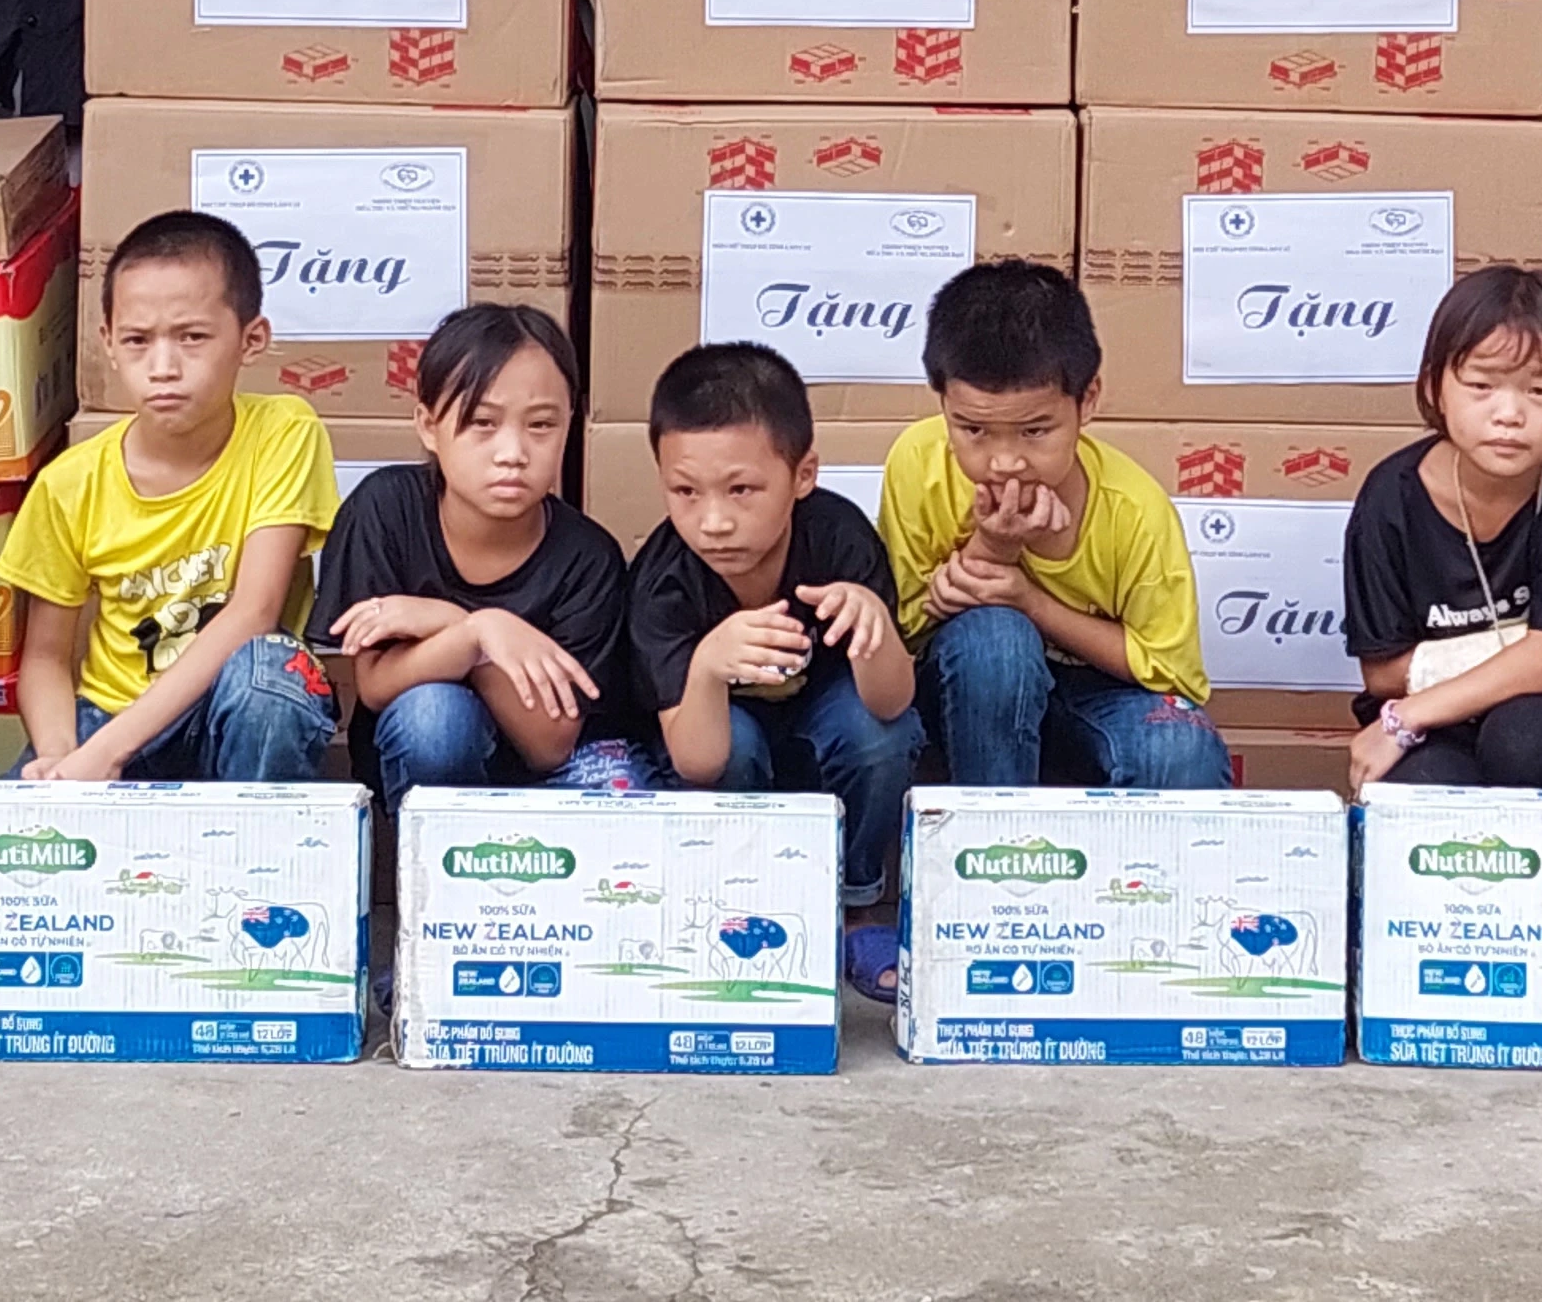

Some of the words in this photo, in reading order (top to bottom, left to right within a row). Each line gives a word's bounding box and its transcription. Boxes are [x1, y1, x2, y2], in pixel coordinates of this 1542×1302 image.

[254, 240, 410, 295] Tặng
[757, 282, 917, 339] Tặng
[1237, 284, 1398, 339] Tặng
[120, 543, 231, 600] MICKEY
[1215, 589, 1348, 645] Tặn
[453, 851, 565, 876] NutiMilk
[965, 852, 1077, 877] NutiMilk
[1418, 848, 1531, 875] NutiMilk
[5, 911, 114, 932] ZEALAND
[423, 923, 476, 941] NEW
[484, 921, 593, 942] ZEALAND
[936, 922, 990, 940] NEW
[996, 920, 1105, 940] ZEALAND
[1387, 919, 1442, 938] NEW
